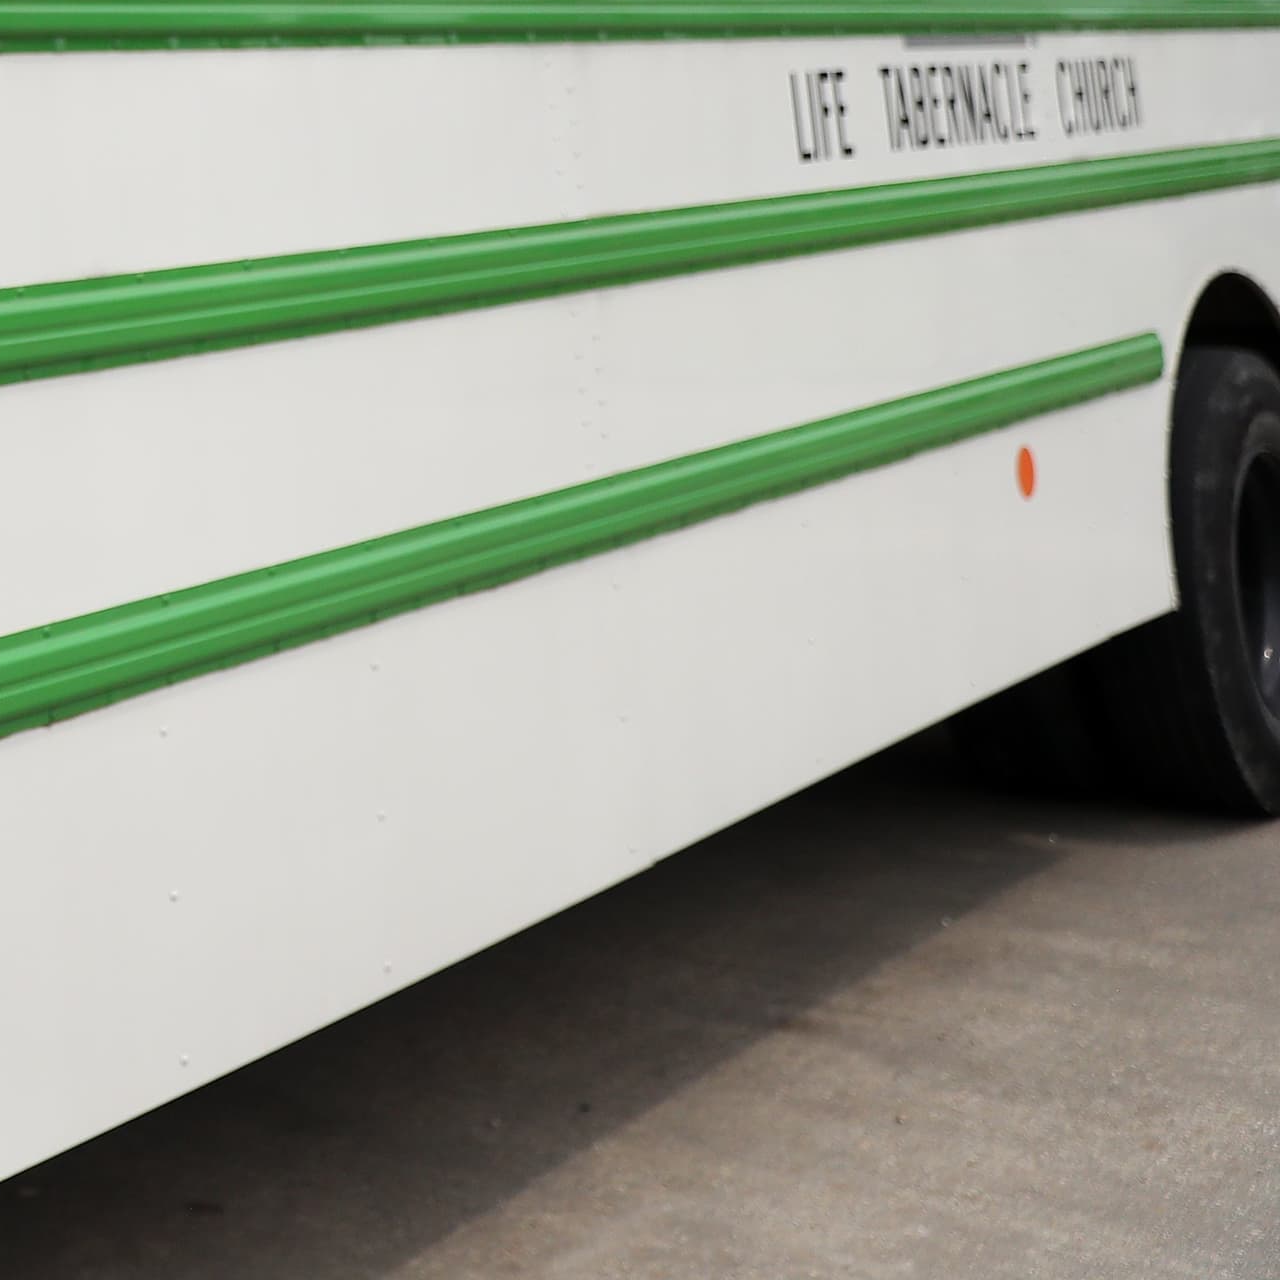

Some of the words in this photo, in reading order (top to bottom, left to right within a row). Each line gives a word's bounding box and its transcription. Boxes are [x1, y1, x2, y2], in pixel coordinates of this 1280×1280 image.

[788, 69, 855, 161] LIFE
[879, 62, 1037, 151] TABERNACLE
[1056, 58, 1143, 136] CHURCH
